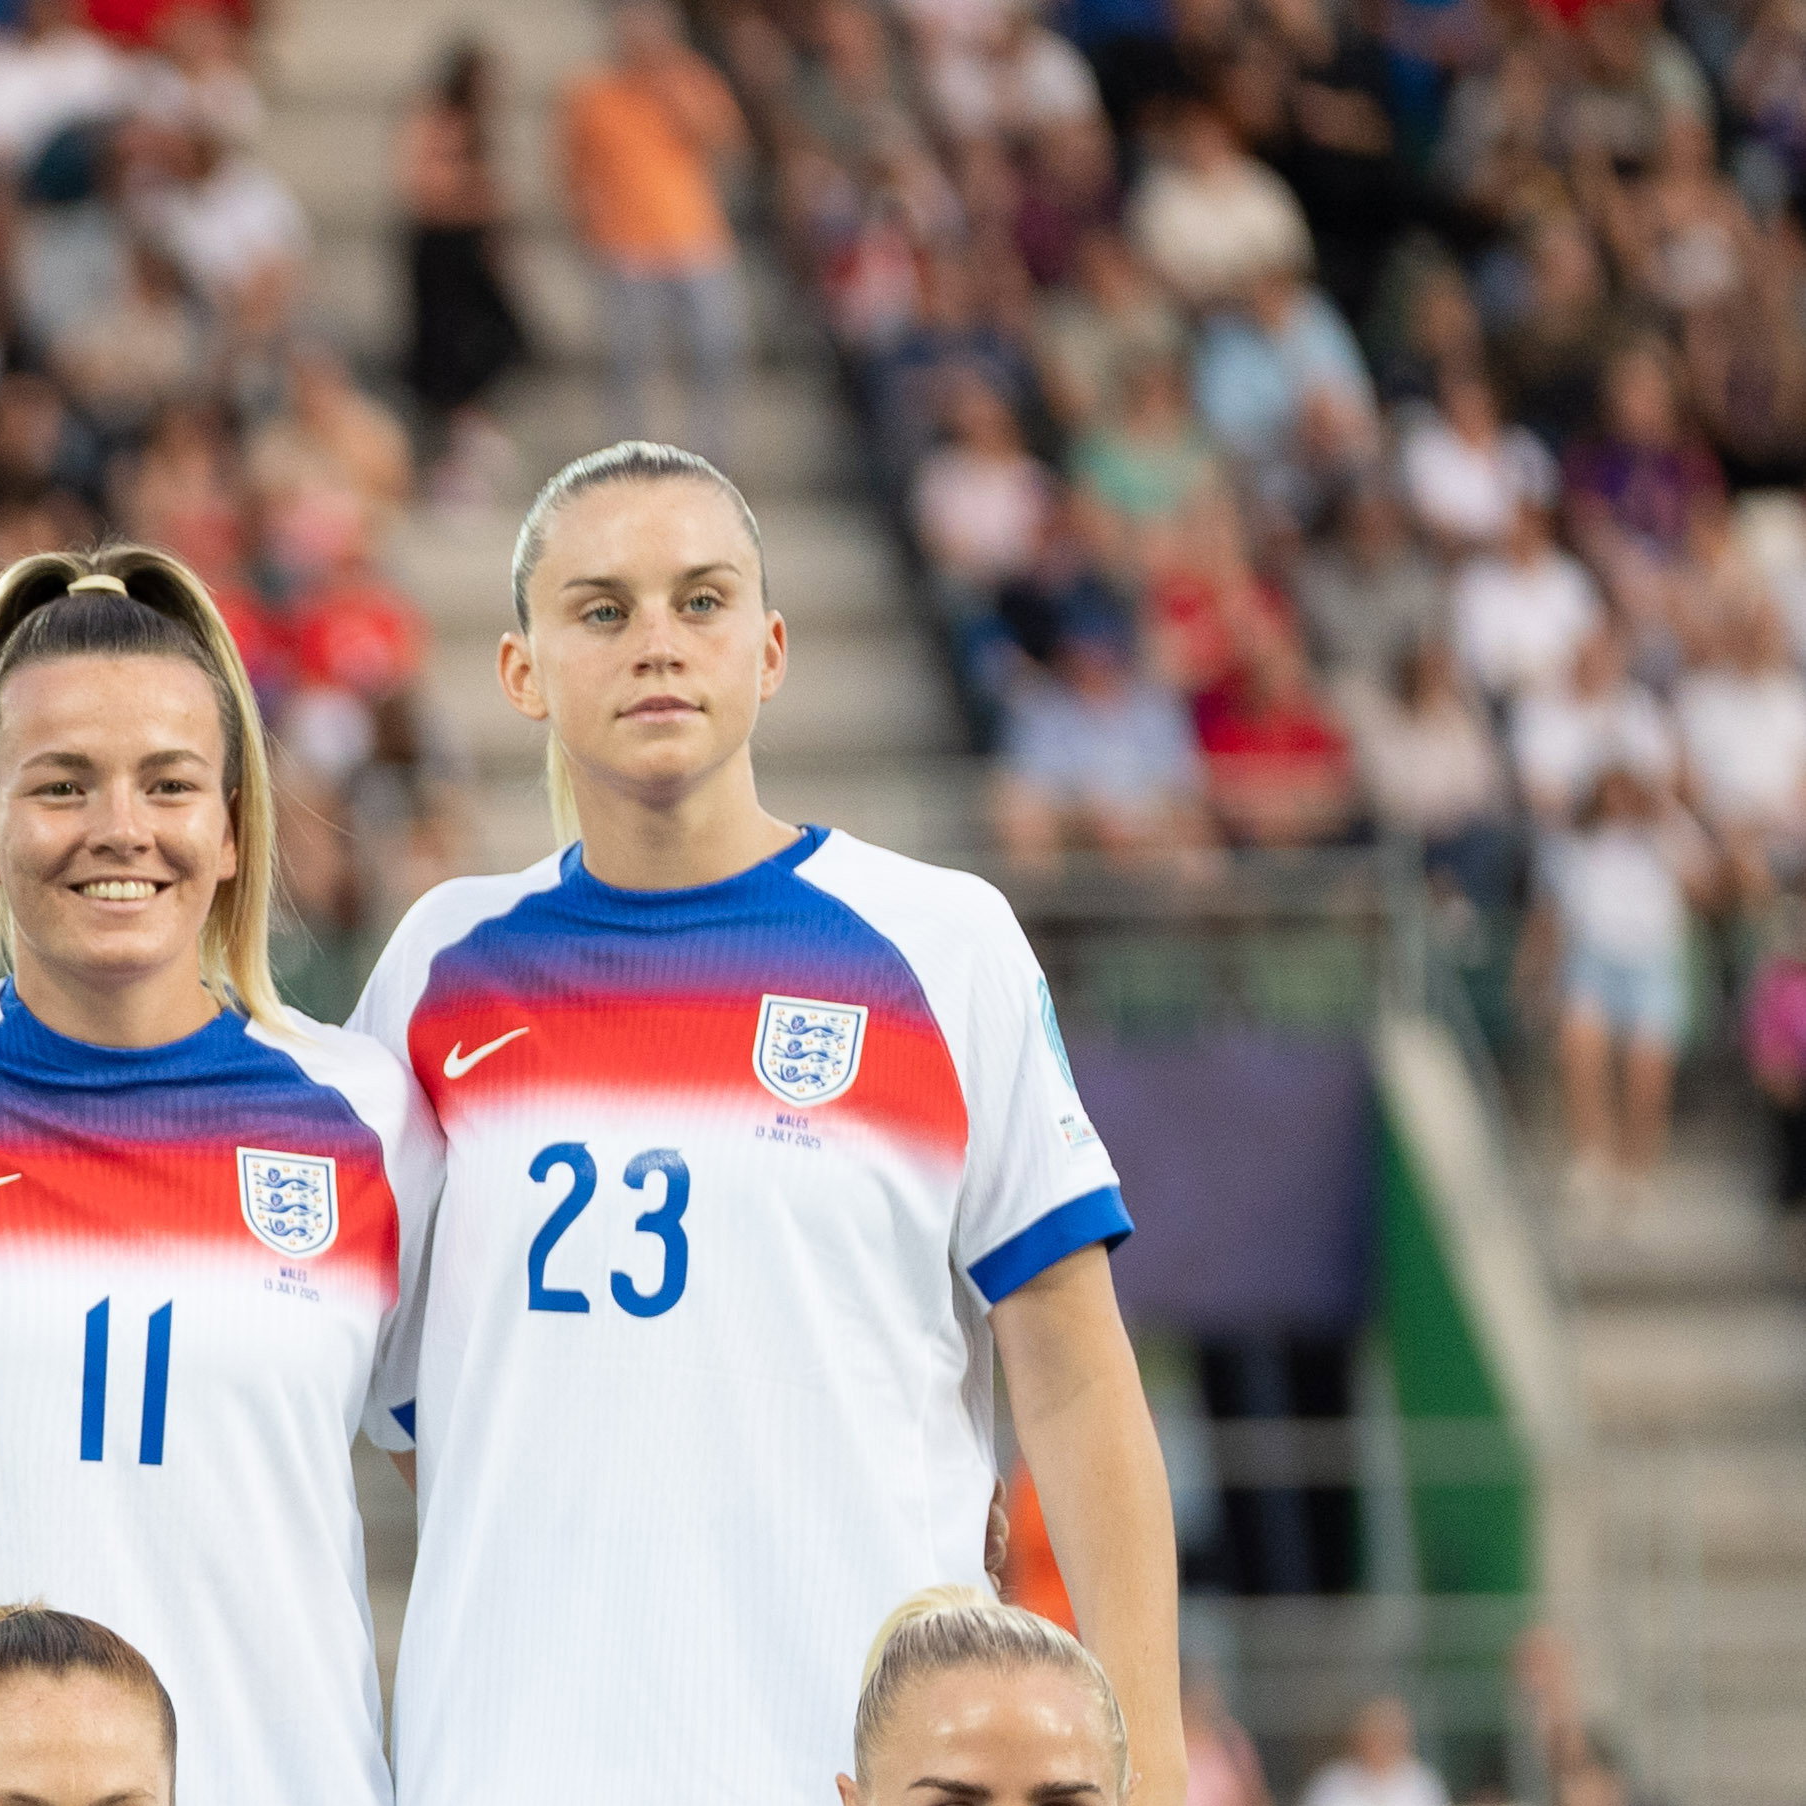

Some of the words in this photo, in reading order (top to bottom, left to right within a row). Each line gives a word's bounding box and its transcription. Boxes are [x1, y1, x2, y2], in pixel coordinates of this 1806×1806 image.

[755, 1125, 766, 1138] 13
[768, 1127, 792, 1143] JULY
[795, 1132, 821, 1149] 2025
[776, 1112, 809, 1129] WALES
[527, 1141, 691, 1318] 23
[80, 1295, 174, 1466] 11
